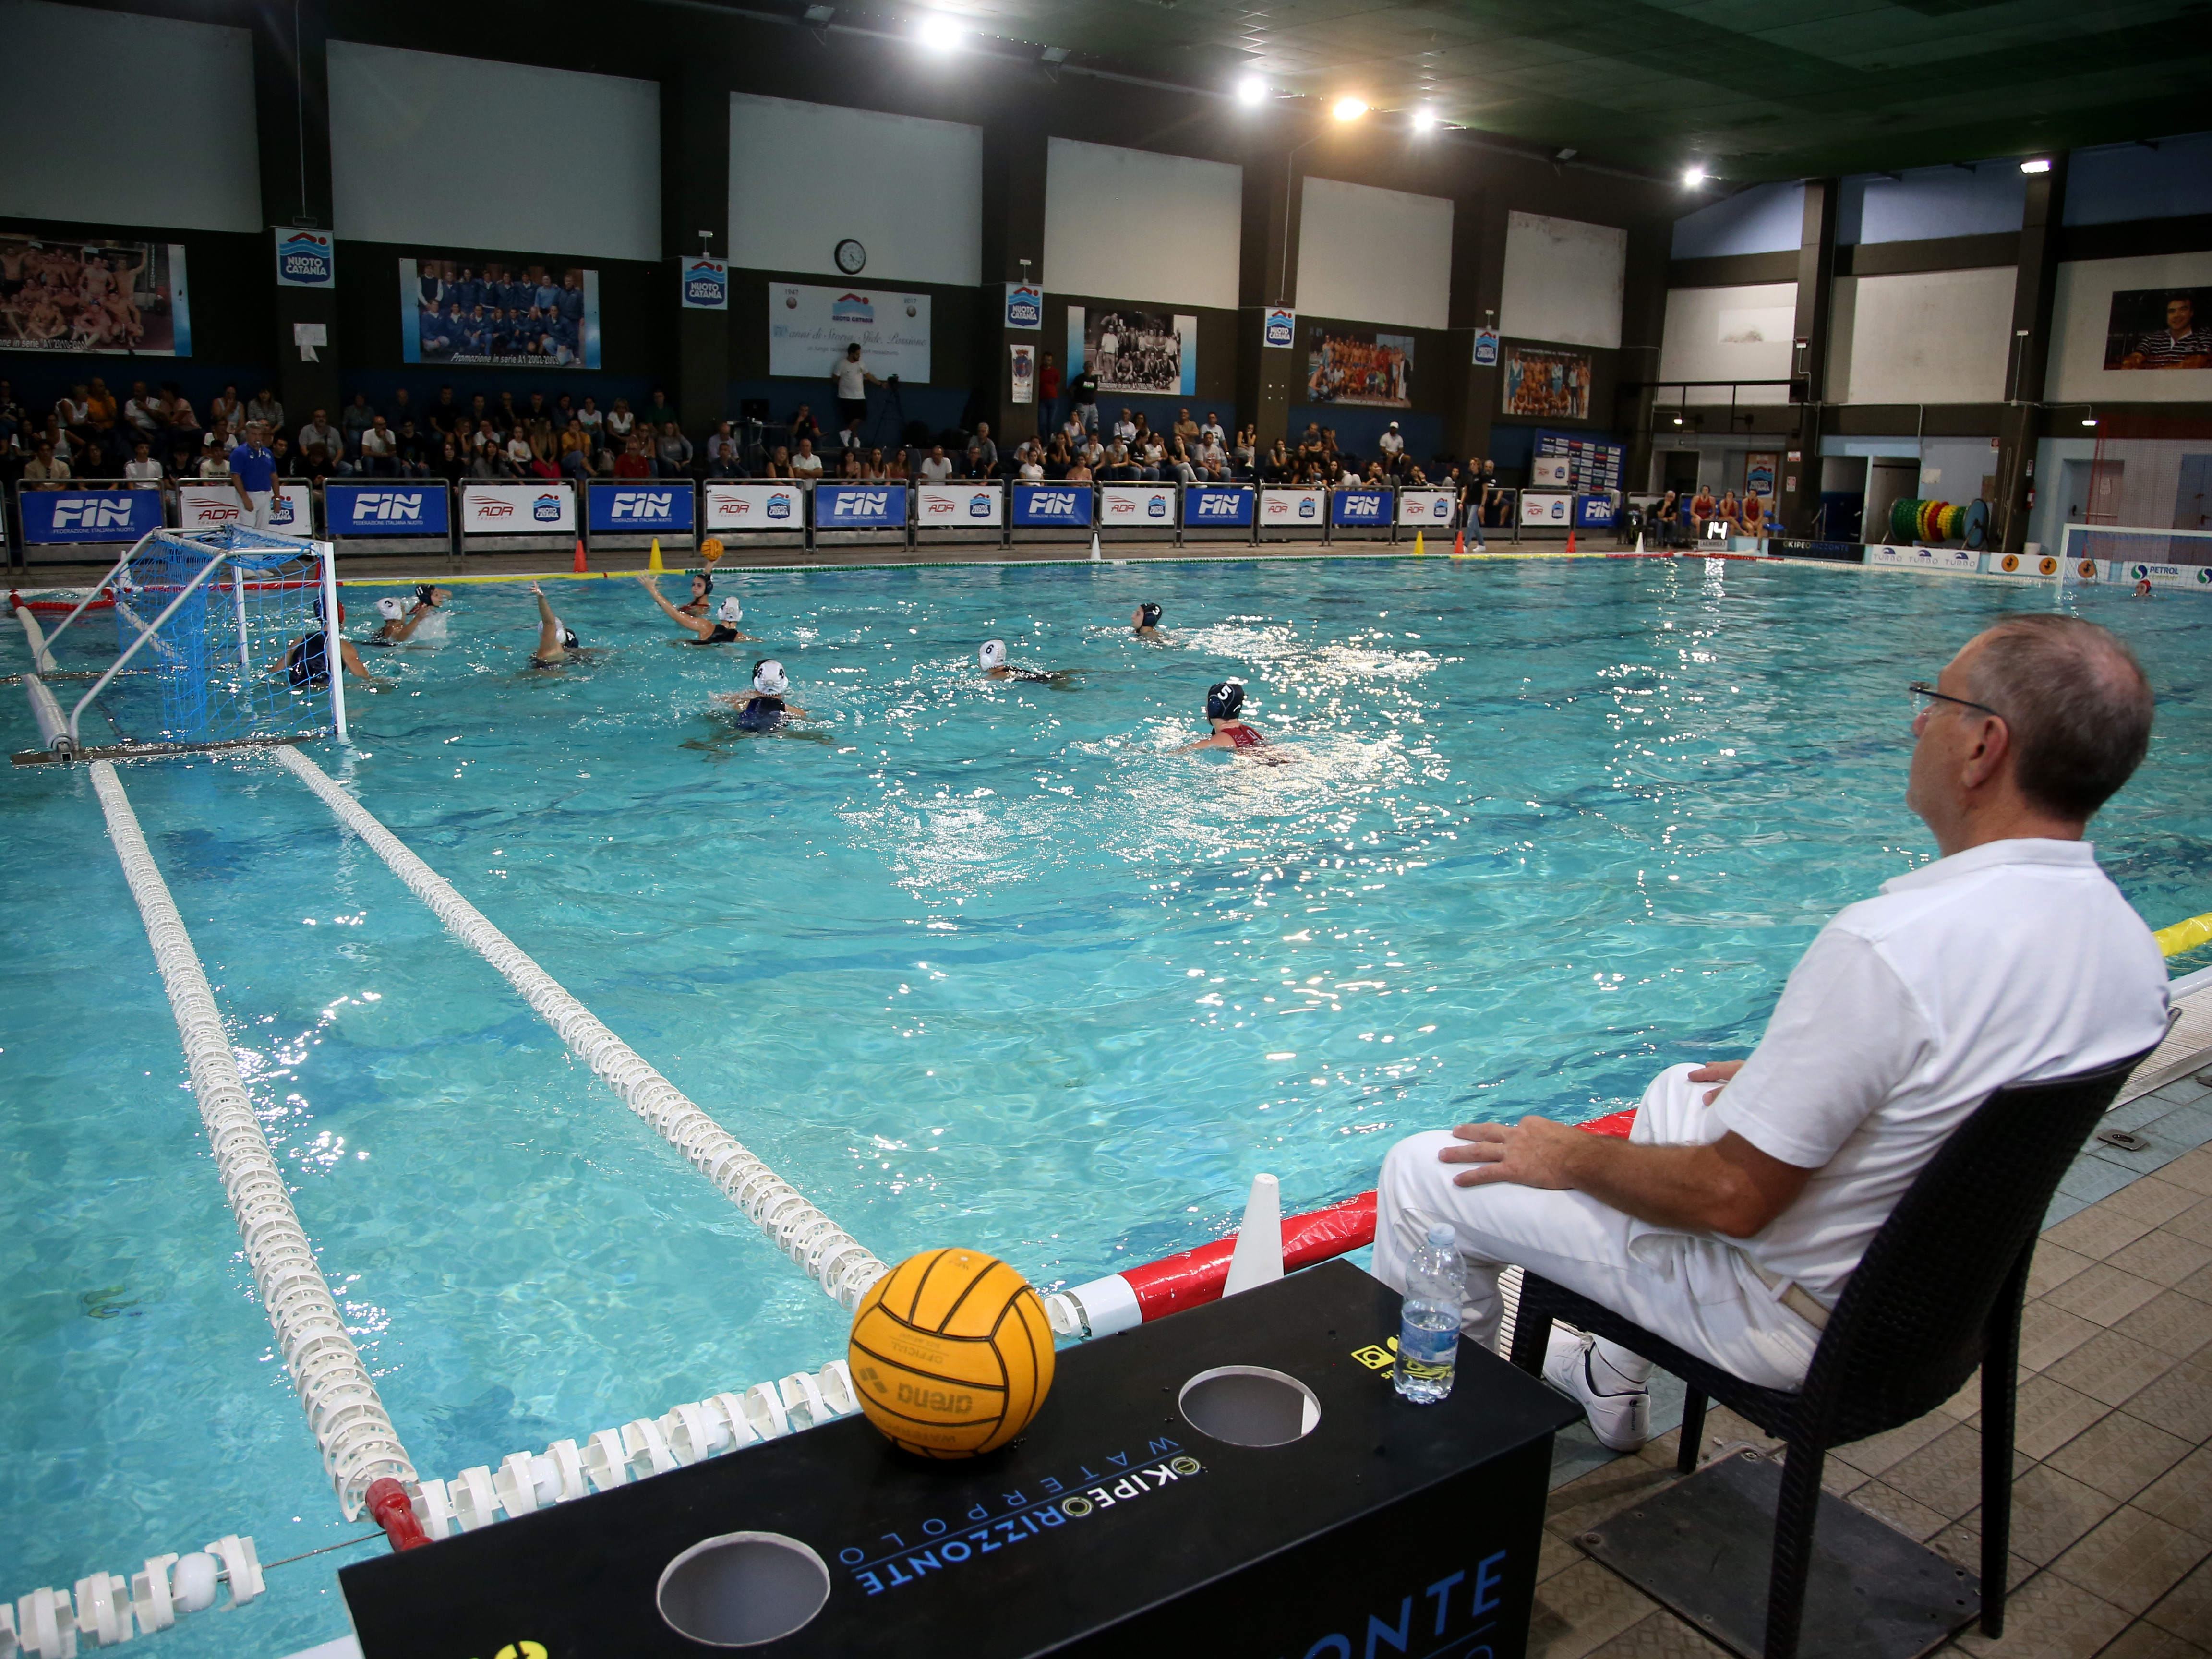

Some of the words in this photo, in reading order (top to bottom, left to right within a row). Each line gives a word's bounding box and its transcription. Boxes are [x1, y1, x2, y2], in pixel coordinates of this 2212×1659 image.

[288, 256, 323, 267] NUOTO
[286, 265, 327, 276] CATANIA
[691, 282, 719, 291] NUOTO
[689, 289, 722, 299] CATANIA
[1012, 305, 1034, 313] NUOTO
[1011, 312, 1037, 320] CATANIA
[22, 338, 39, 348] serie
[450, 352, 491, 363] Promozione
[493, 354, 499, 363] in
[500, 355, 517, 364] serie
[517, 355, 526, 364] A1
[352, 493, 423, 519] FIN
[611, 493, 672, 517] FIN
[719, 505, 749, 513] ADR
[834, 492, 888, 515] FIN
[928, 504, 954, 512] ADR
[1029, 493, 1076, 514] FIN
[1198, 494, 1240, 514] FIN
[1344, 496, 1380, 515] FIN
[53, 498, 132, 527] FIN
[478, 506, 514, 516] ADR
[1707, 521, 1728, 540] 14
[1152, 606, 1160, 615] 3
[986, 644, 994, 654] 6
[1217, 685, 1232, 700] 5
[898, 1382, 973, 1414] arena
